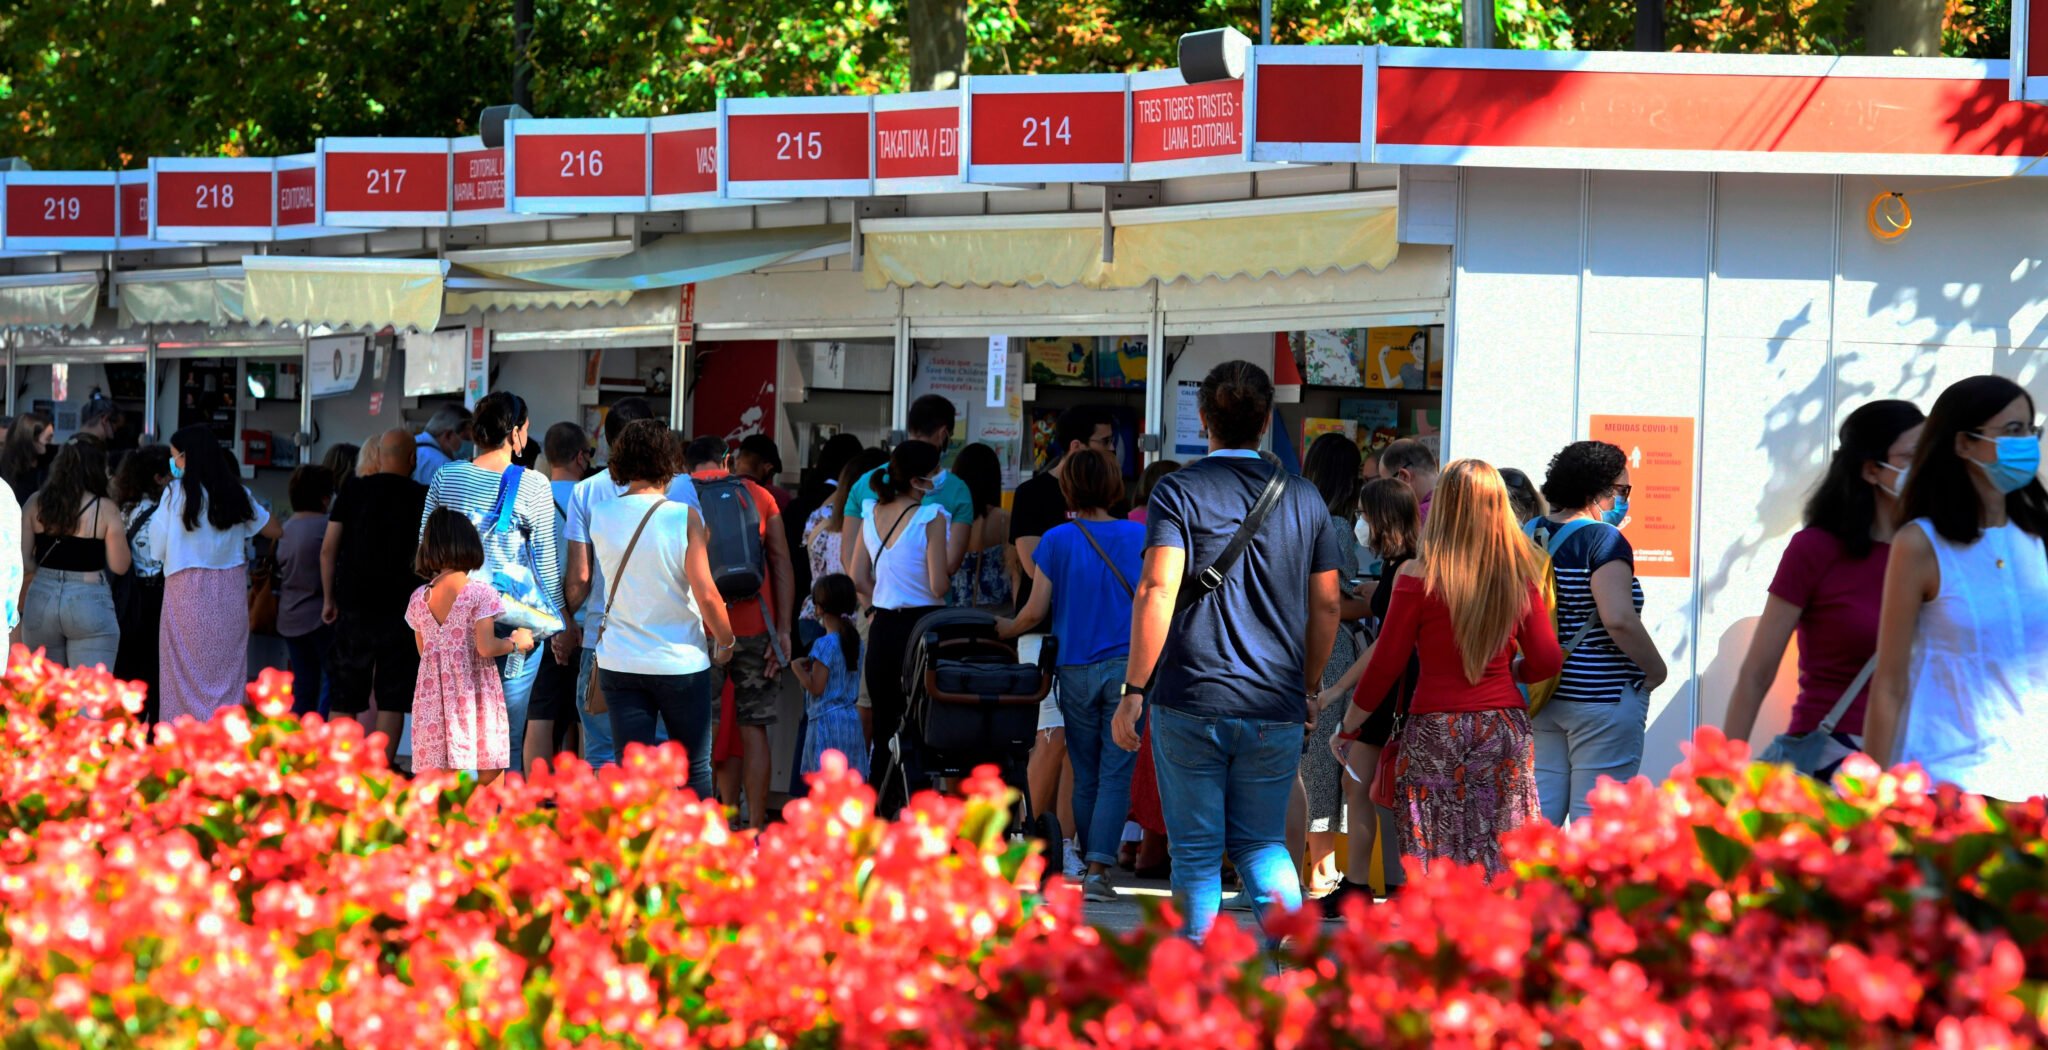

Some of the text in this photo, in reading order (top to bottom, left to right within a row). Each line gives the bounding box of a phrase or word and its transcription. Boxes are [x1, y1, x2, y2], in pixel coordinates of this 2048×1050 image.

[1138, 100, 1162, 123] TRES
[1164, 96, 1195, 121] TIGRES
[1196, 92, 1234, 118] TRISTES
[878, 128, 930, 159] TAKATUKA
[931, 127, 938, 158] /
[1021, 115, 1072, 147] 214
[1163, 126, 1190, 151] LIANA
[1192, 122, 1237, 149] EDITORIAL
[776, 131, 823, 161] 215
[470, 158, 499, 178] EDITORIAL
[560, 150, 604, 178] 216
[366, 168, 407, 195] 217
[43, 196, 81, 221] 219
[196, 184, 235, 209] 218
[281, 186, 315, 211] EDITORIAL
[926, 366, 942, 374] Save
[944, 367, 956, 375] the
[1604, 423, 1679, 433] MEDIDAS COVID-19
